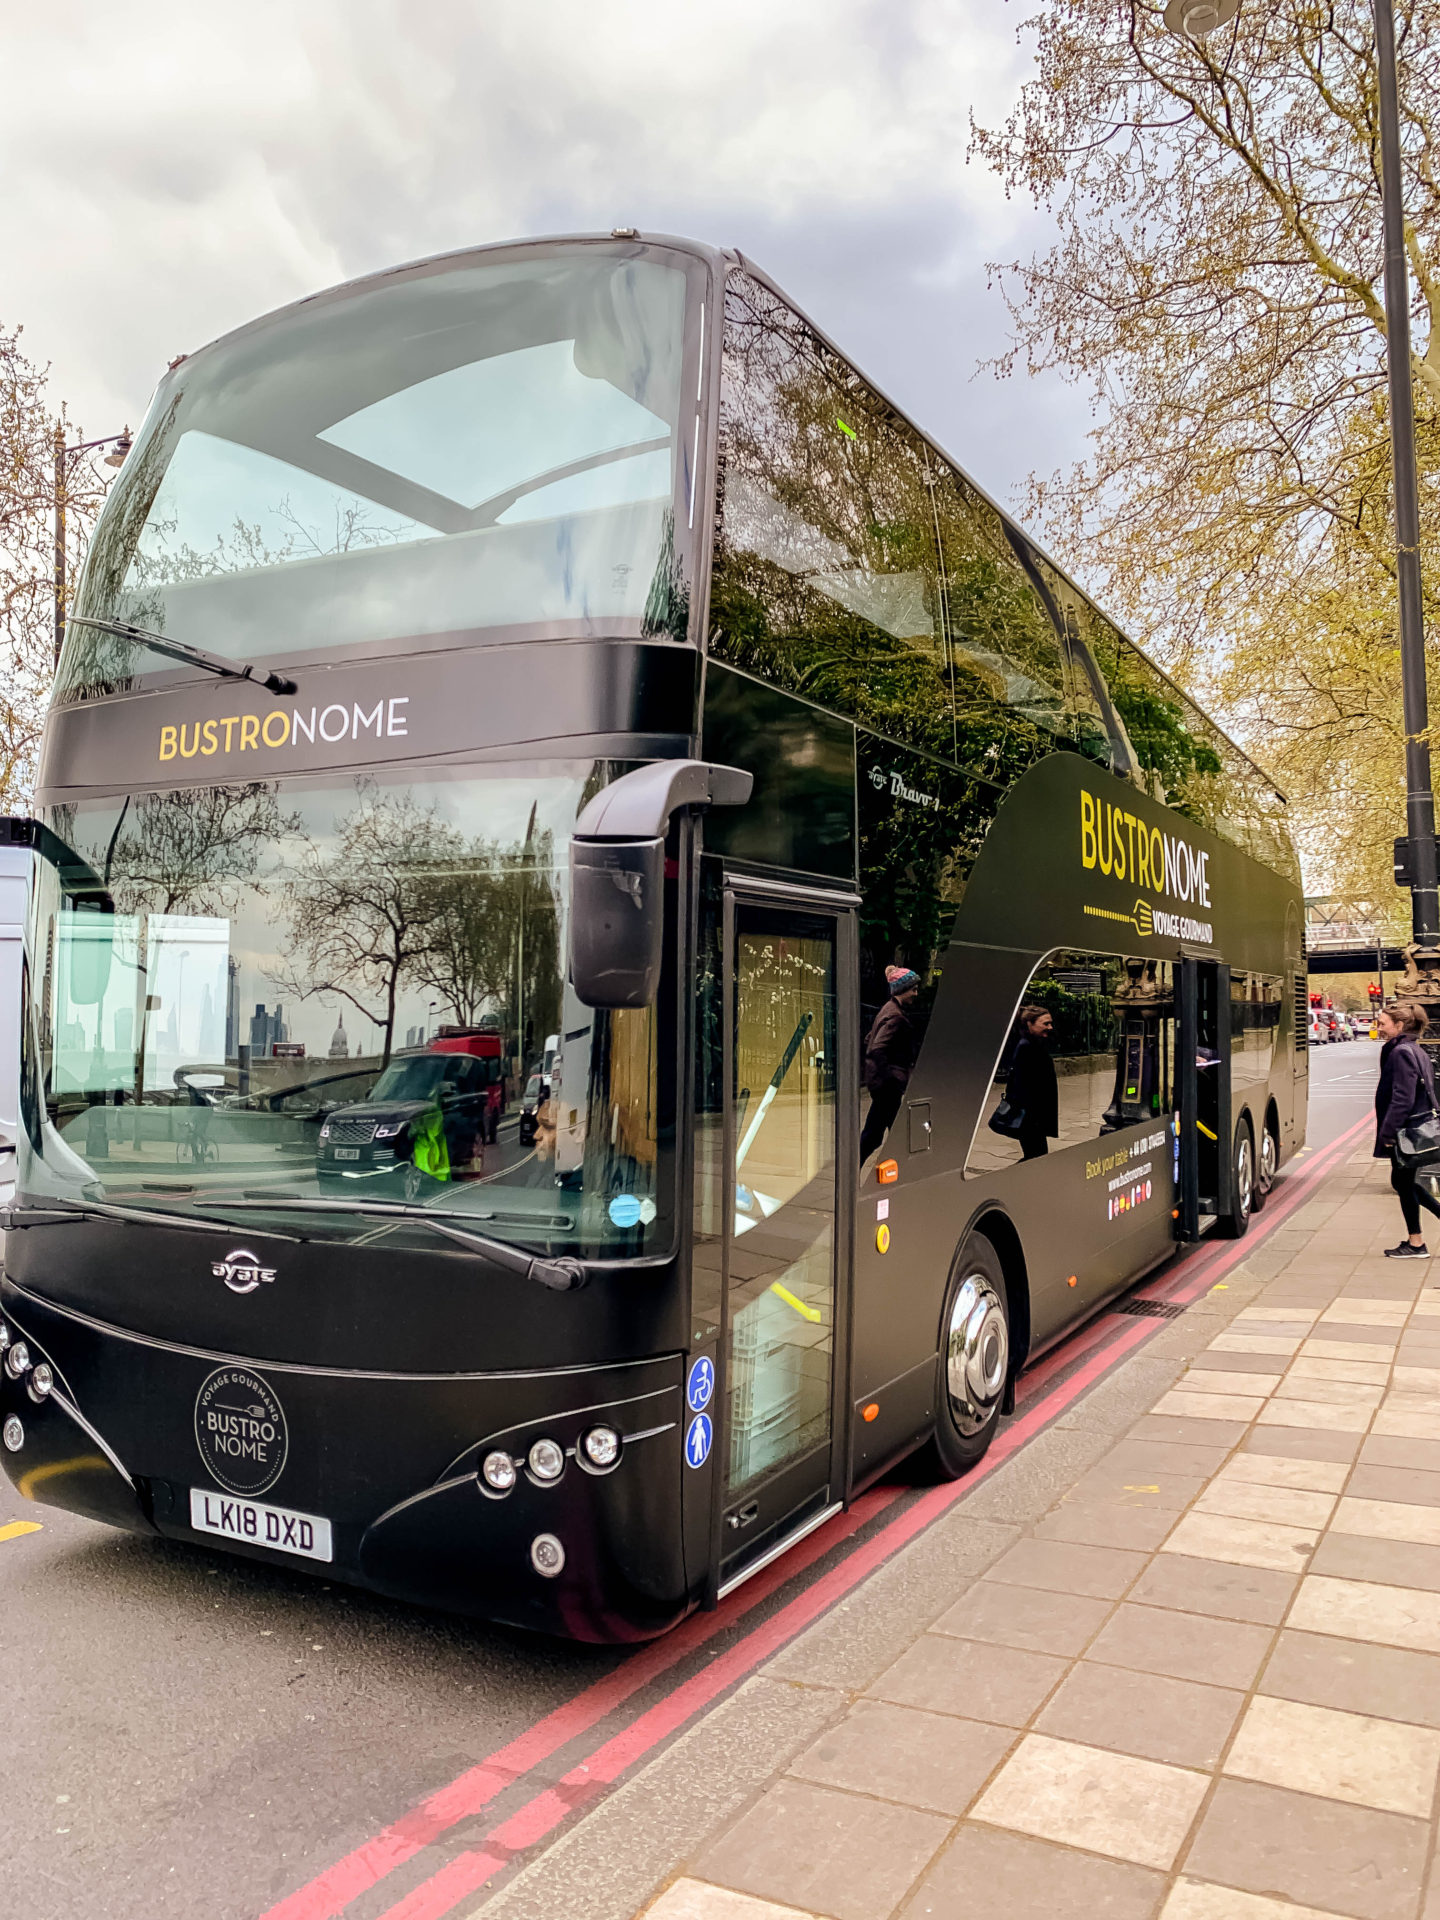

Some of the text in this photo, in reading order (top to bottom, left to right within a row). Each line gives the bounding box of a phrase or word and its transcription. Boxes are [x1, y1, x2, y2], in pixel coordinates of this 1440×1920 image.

[159, 697, 410, 761] BUSTRONOME
[890, 771, 933, 807] Bravo
[1081, 789, 1212, 909] BUSTRONOME
[1152, 910, 1213, 944] VOYAGE GOURMAND
[1085, 1156, 1101, 1179] Book
[1102, 1155, 1115, 1177] your
[201, 1373, 279, 1422] VOYAGE GOURMAND
[207, 1411, 275, 1442] BUSTRO
[215, 1433, 267, 1463] NOME
[205, 1496, 313, 1551] LK18 DXD
